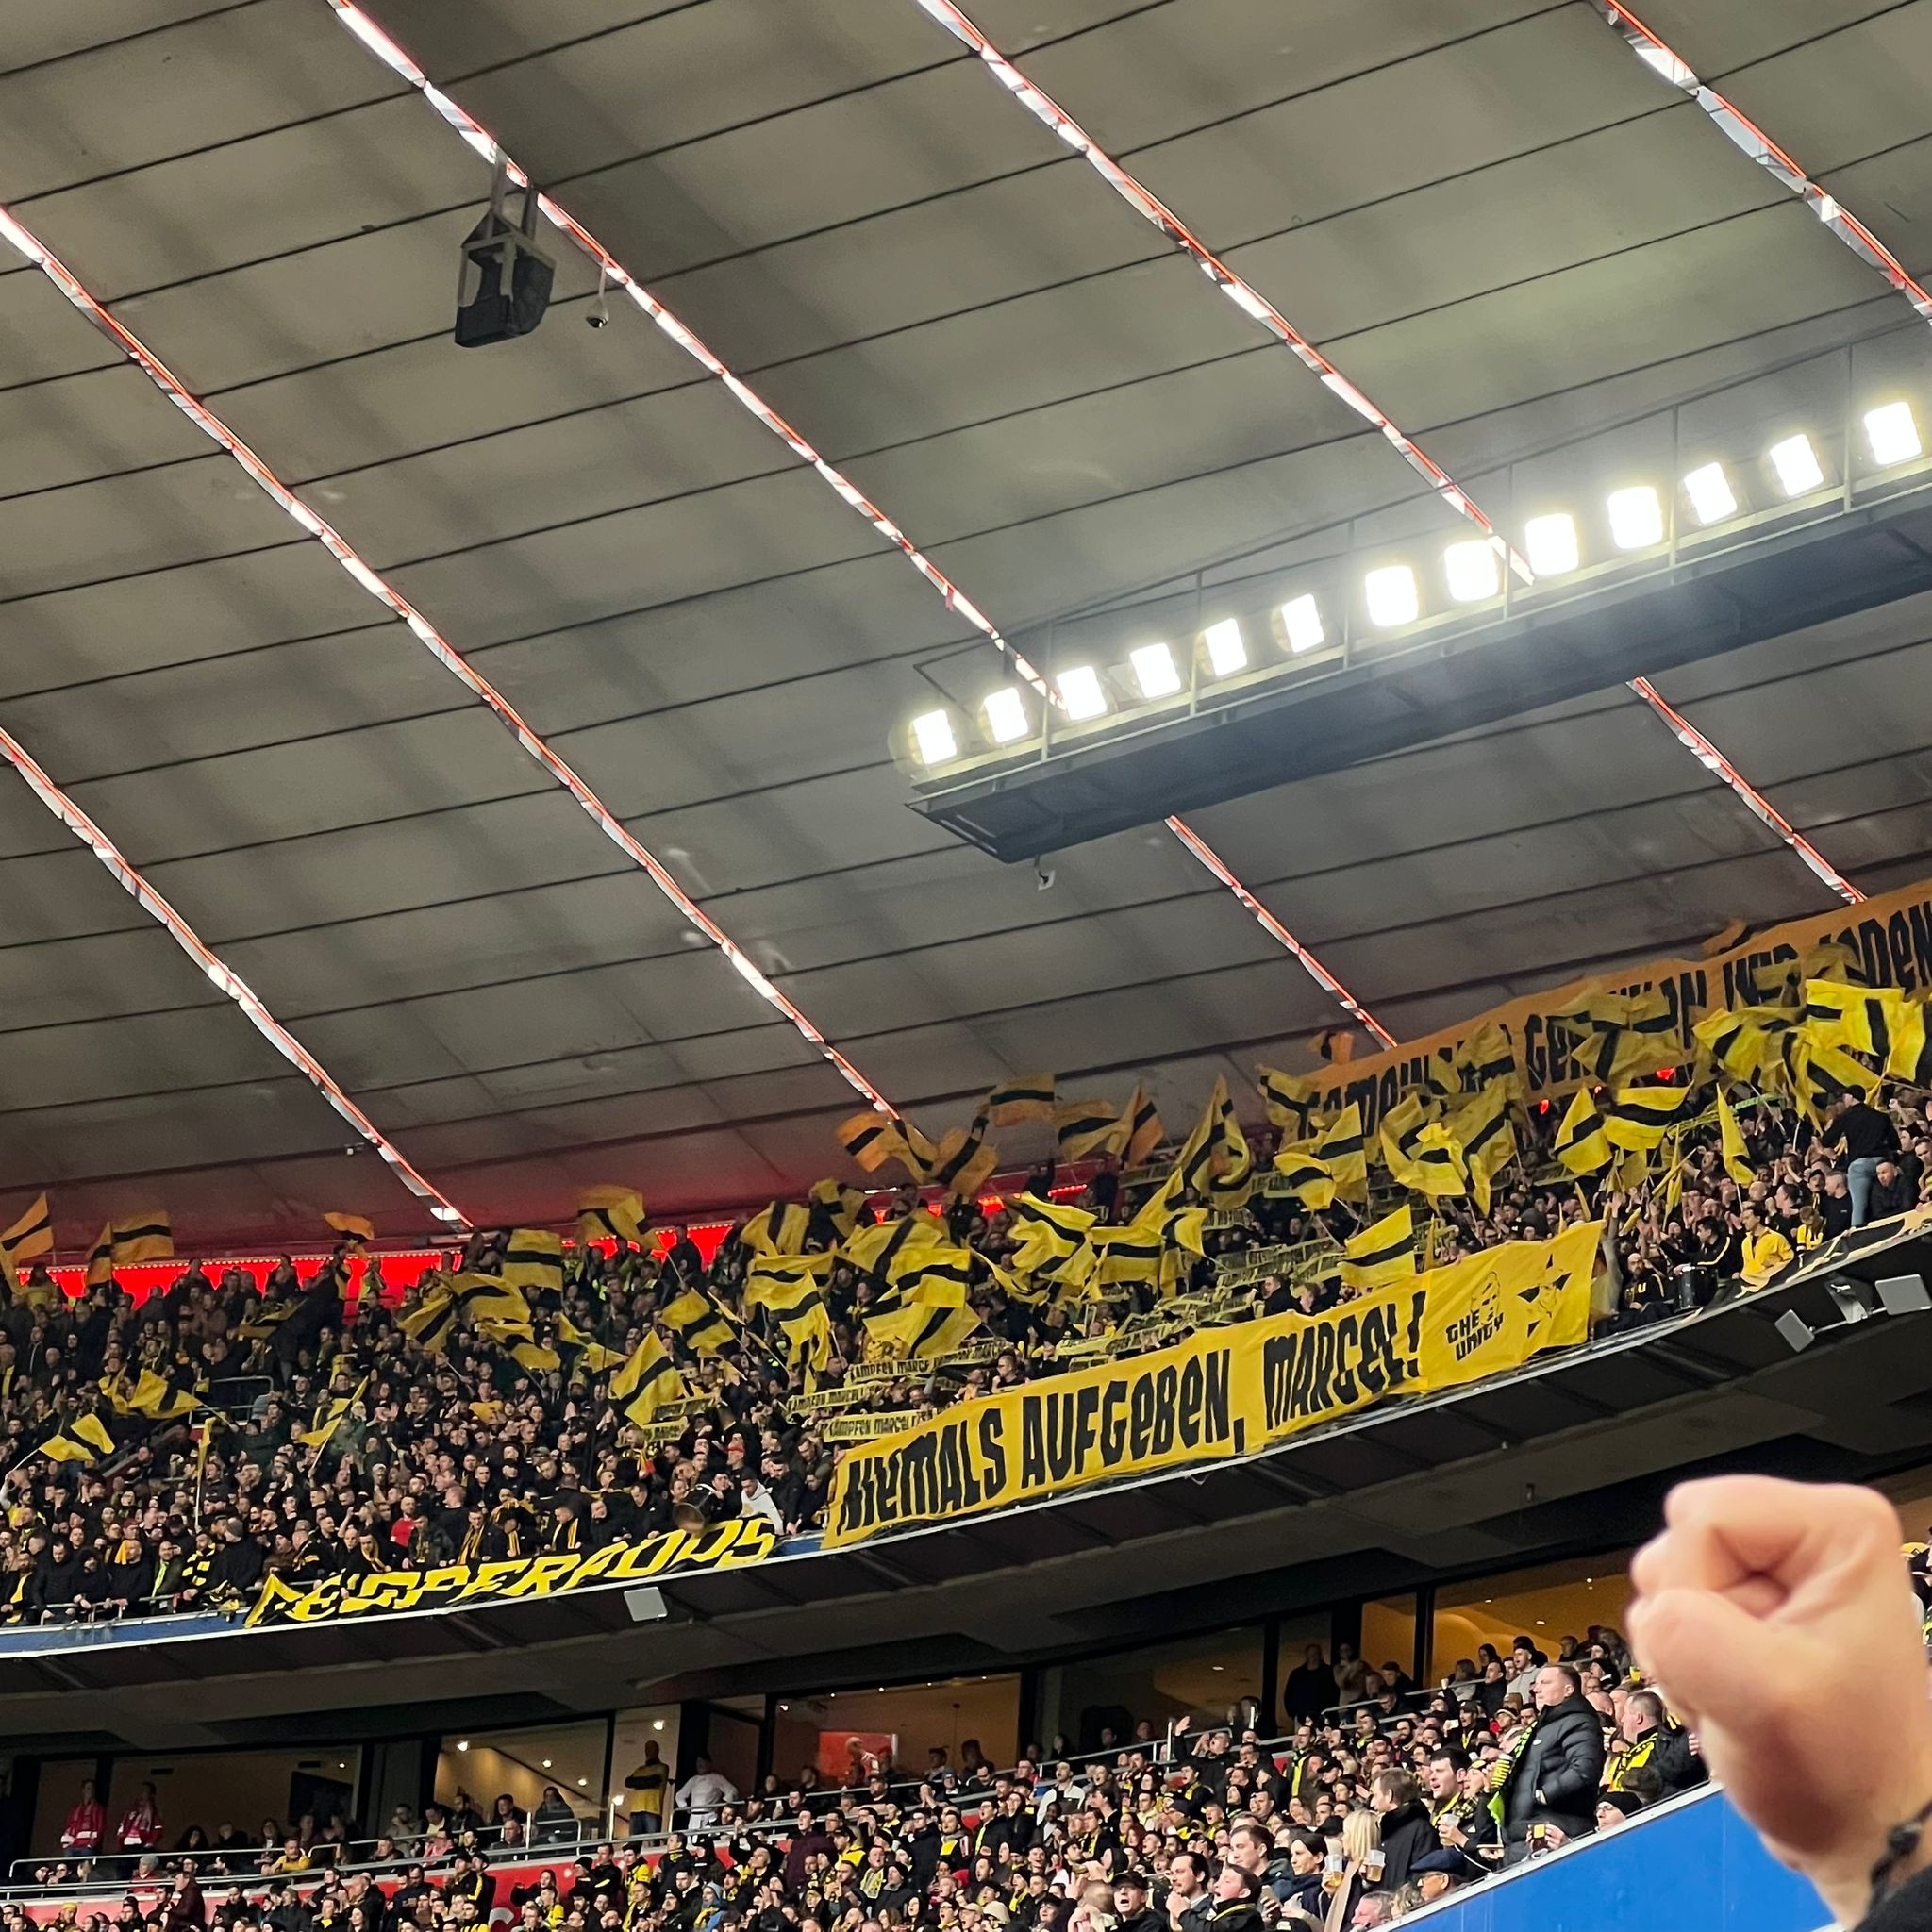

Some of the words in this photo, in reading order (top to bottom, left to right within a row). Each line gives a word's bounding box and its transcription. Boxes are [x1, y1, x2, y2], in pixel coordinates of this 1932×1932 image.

[836, 1408, 1007, 1536] NIEMALS
[1263, 1291, 1426, 1431] MARCEL!
[244, 1517, 775, 1628] DESPERADOS
